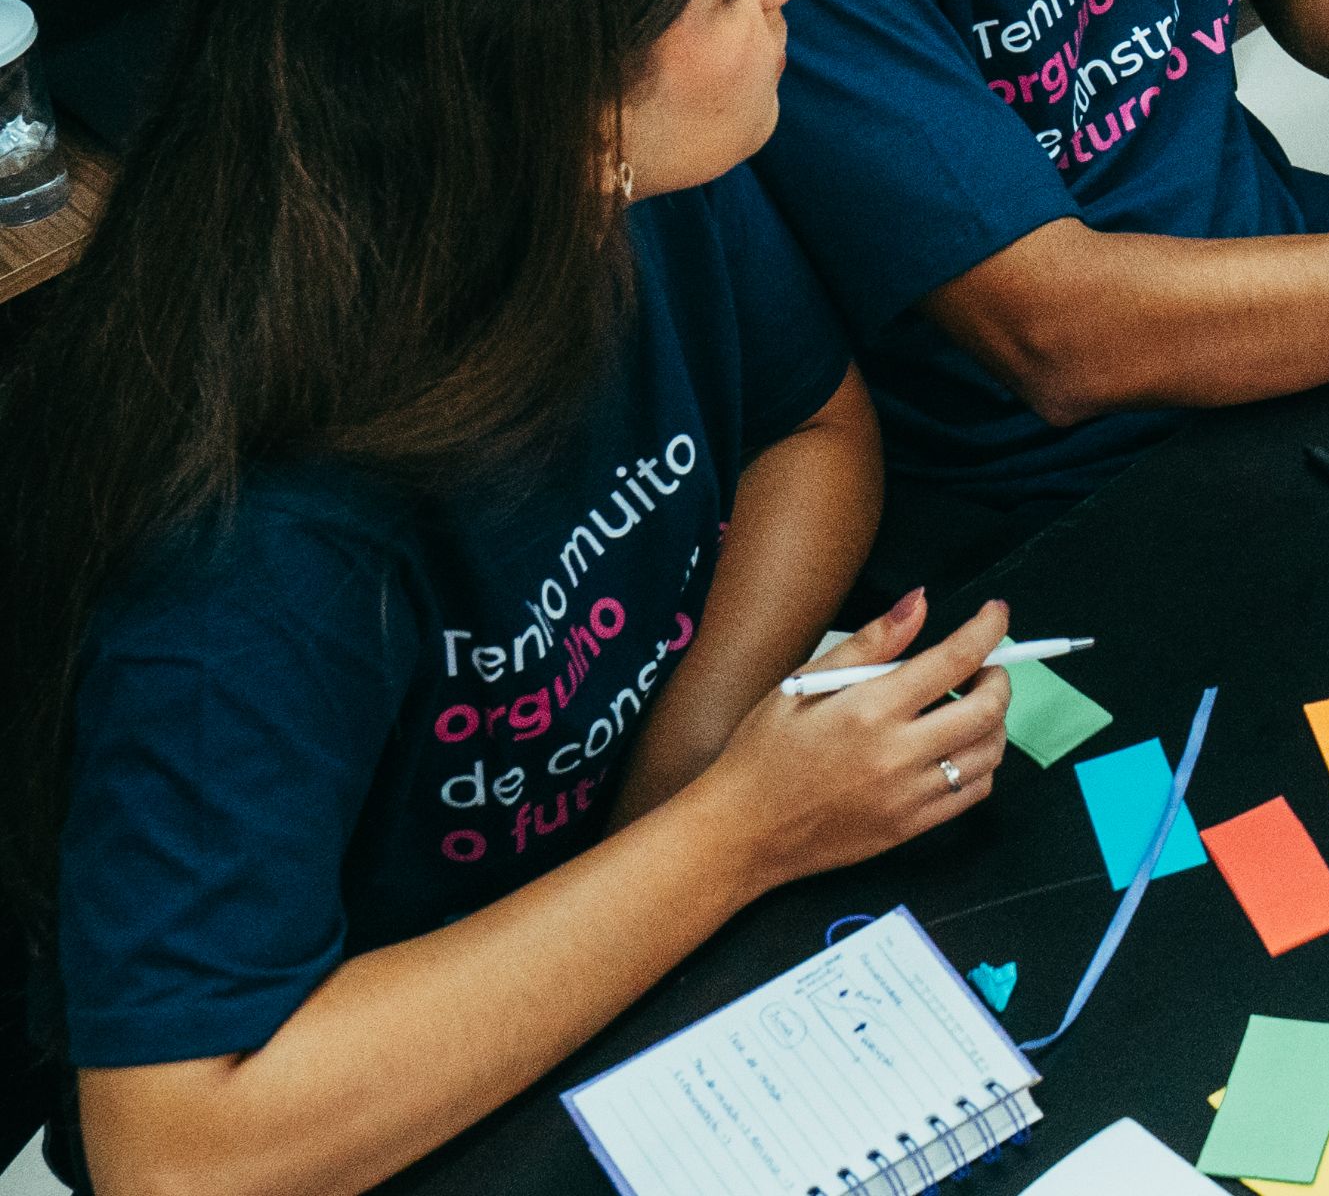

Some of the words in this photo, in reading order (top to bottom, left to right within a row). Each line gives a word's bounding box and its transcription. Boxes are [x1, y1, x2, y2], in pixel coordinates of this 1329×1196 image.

[443, 578, 567, 683] Tenho
[560, 433, 696, 588] muito
[434, 597, 626, 742] orgulho
[441, 760, 525, 808] de
[441, 829, 487, 862] o
